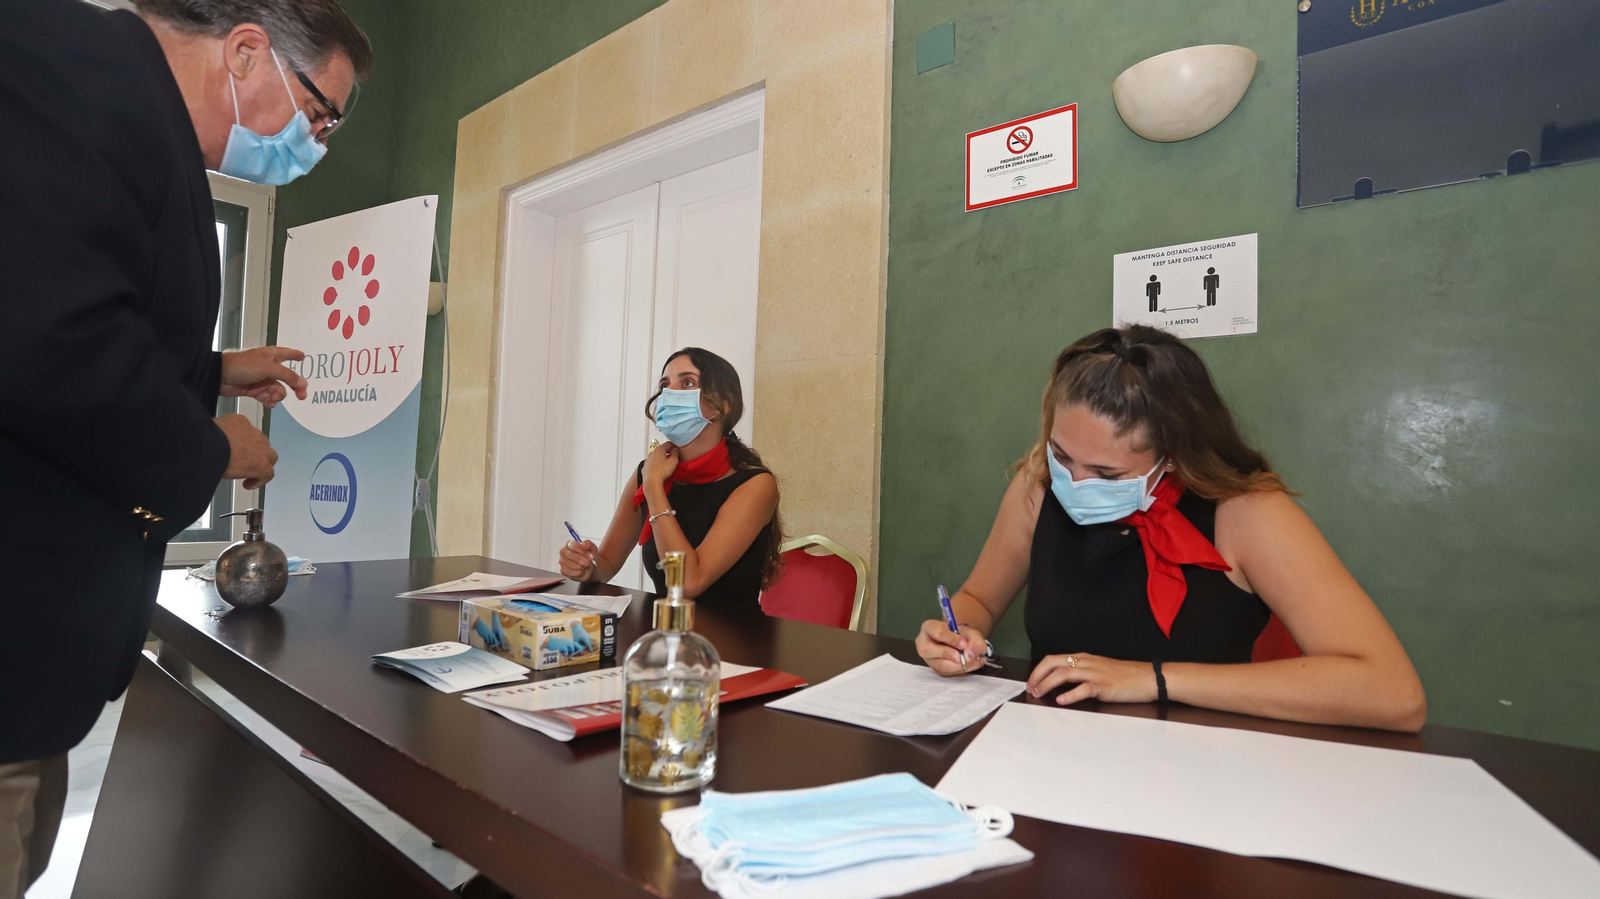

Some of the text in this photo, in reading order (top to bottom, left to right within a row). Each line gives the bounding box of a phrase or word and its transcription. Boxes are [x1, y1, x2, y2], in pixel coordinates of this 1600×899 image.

[987, 164, 1005, 173] EXCEPTO
[1026, 153, 1053, 163] HABILITADAS
[1000, 155, 1023, 164] PROHIBIDO
[1131, 241, 1237, 261] MANTENGA DISTANCIA SEGURIDAD
[1183, 254, 1213, 263] DISTANCE
[1175, 317, 1199, 325] METROS
[311, 384, 377, 405] ANDALUCÍA
[309, 483, 349, 503] ACERINOX
